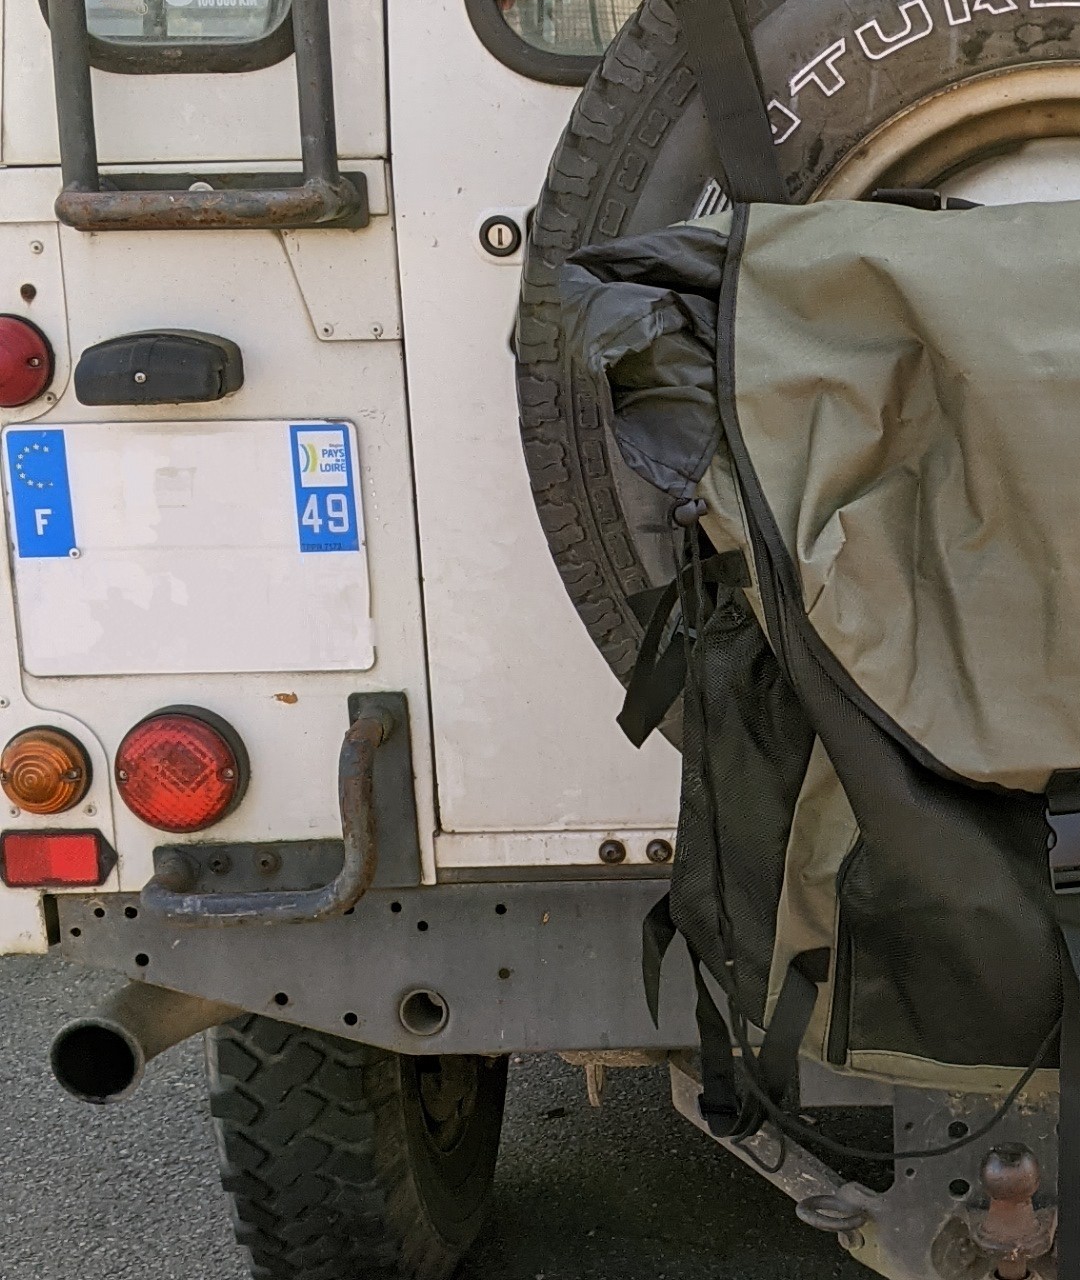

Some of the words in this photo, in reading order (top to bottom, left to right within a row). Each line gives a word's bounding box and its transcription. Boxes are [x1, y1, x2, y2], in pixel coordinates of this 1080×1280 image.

[321, 448, 346, 459] PAYS
[319, 463, 347, 473] LOIRE
[34, 508, 52, 536] F
[302, 493, 349, 533] 49
